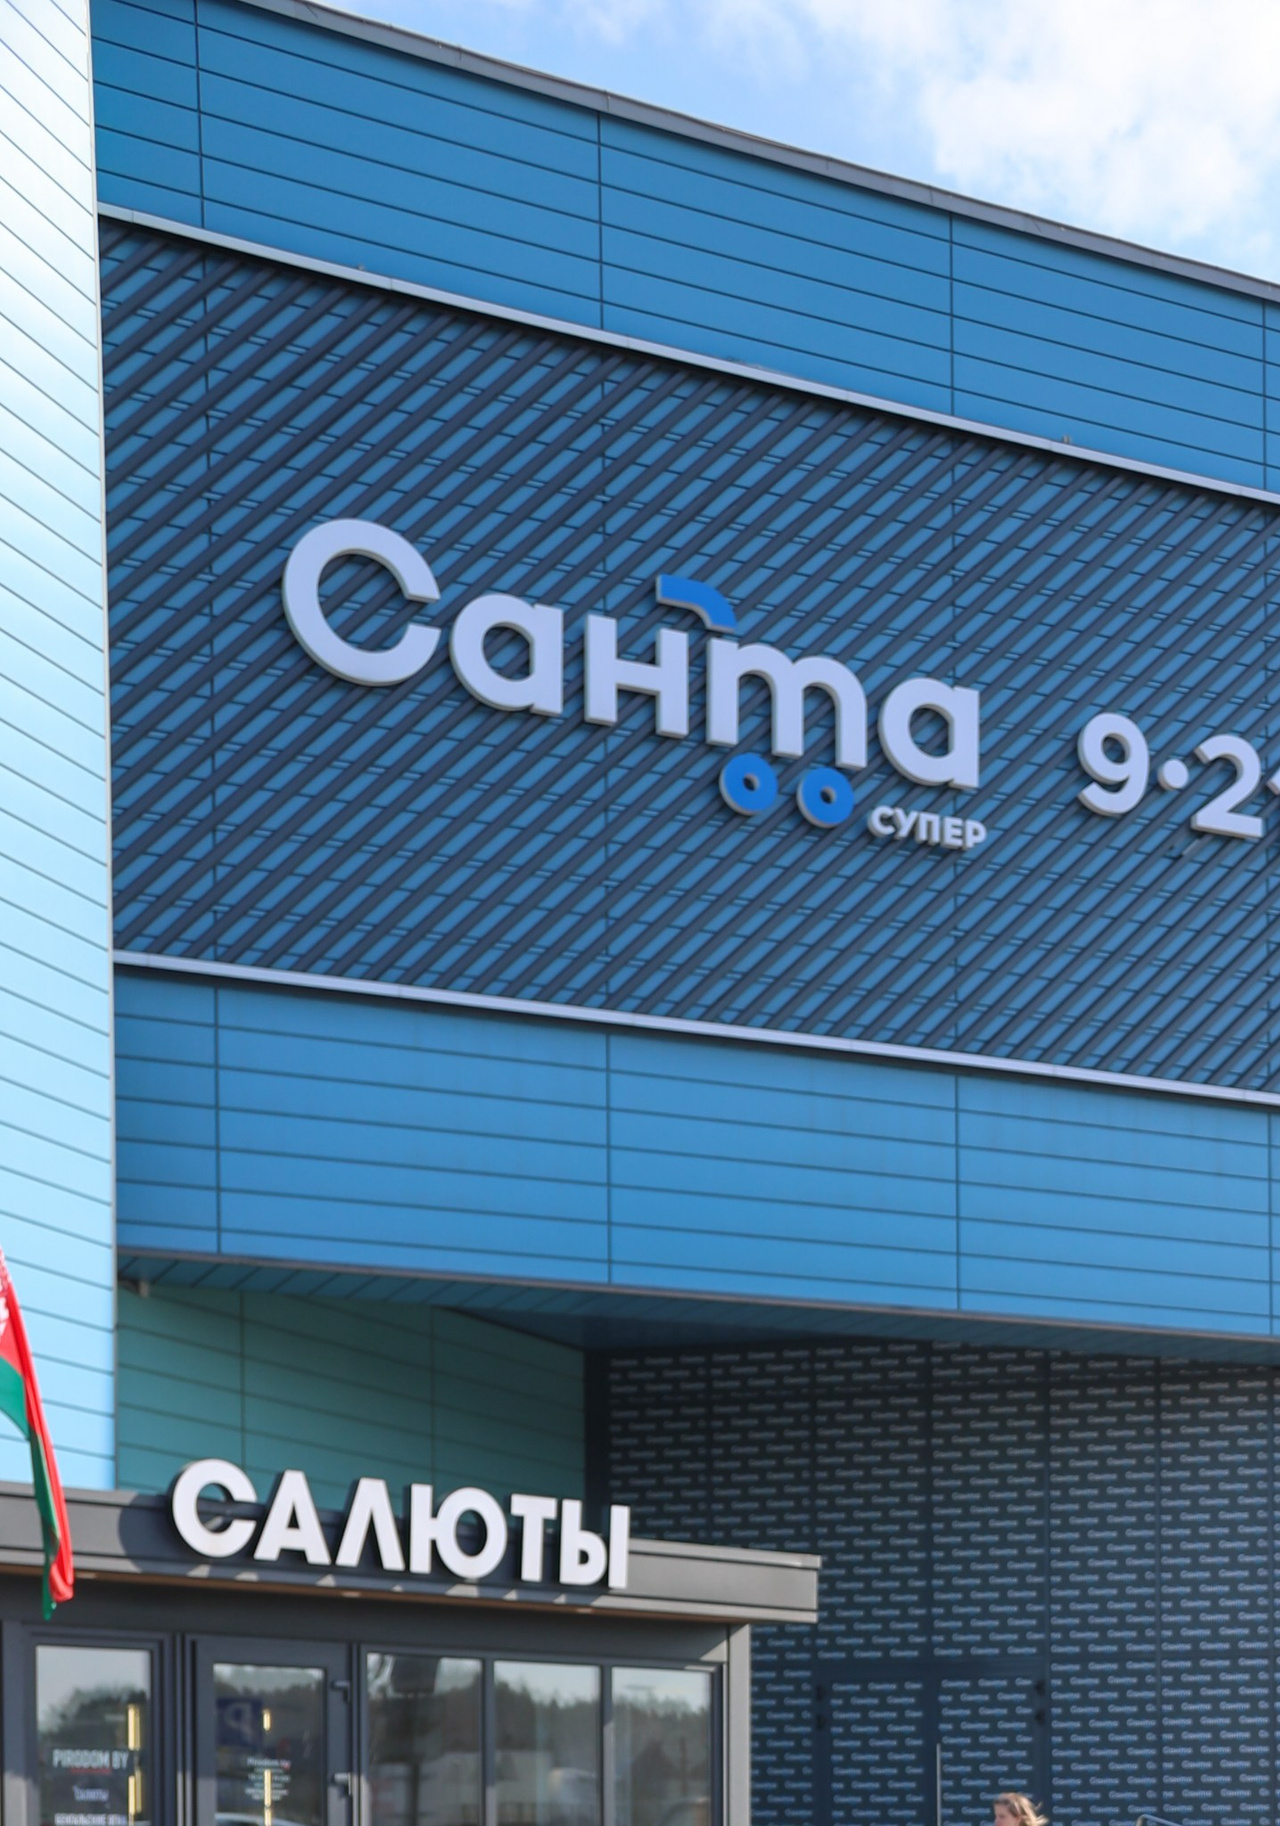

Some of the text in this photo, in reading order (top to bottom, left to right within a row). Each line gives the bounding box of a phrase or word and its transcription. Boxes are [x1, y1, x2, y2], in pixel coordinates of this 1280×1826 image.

[283, 517, 981, 790] Санта
[866, 803, 988, 851] СУПЕР
[171, 1458, 631, 1589] САЛЮТЫ
